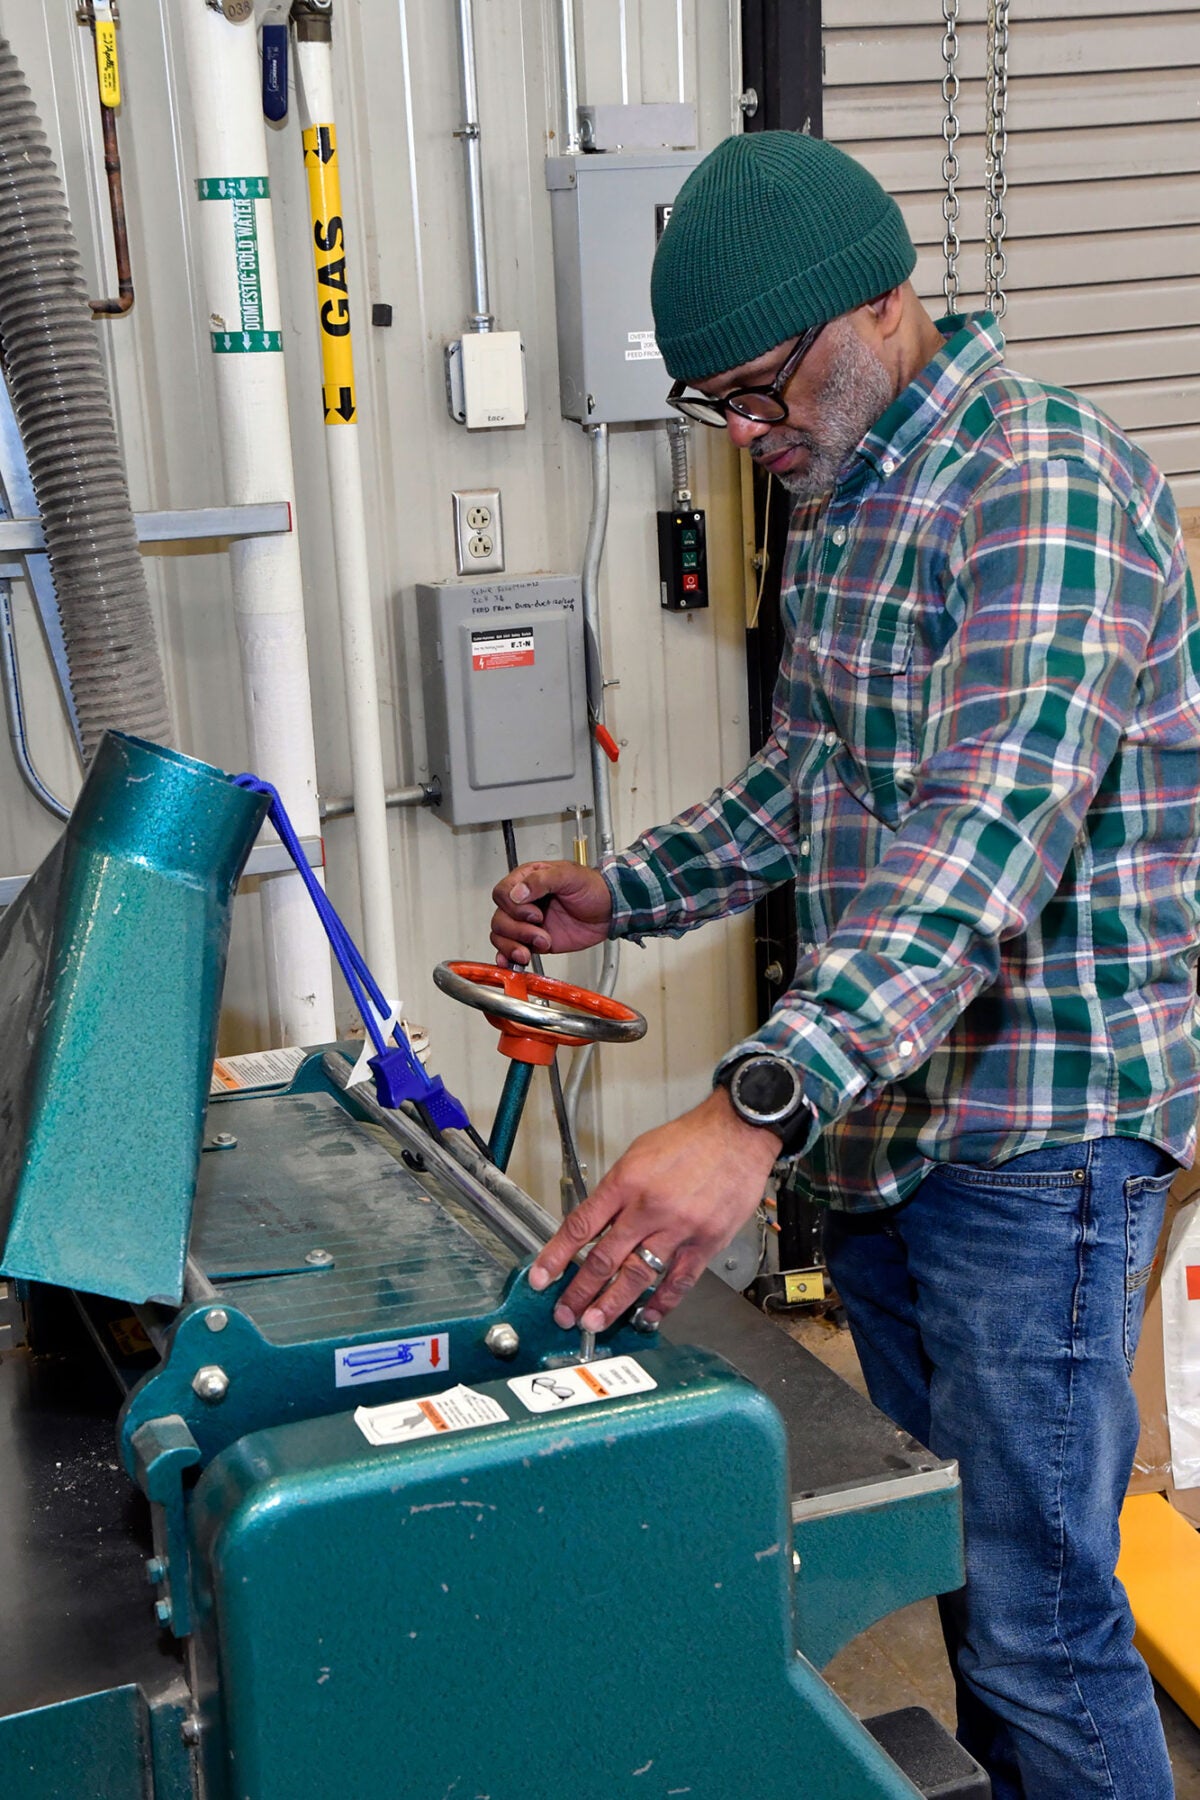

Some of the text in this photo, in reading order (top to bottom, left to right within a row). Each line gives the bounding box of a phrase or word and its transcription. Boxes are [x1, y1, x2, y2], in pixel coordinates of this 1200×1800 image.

[234, 199, 260, 331] DOMESTIC COLD WATER
[314, 216, 350, 337] GAS
